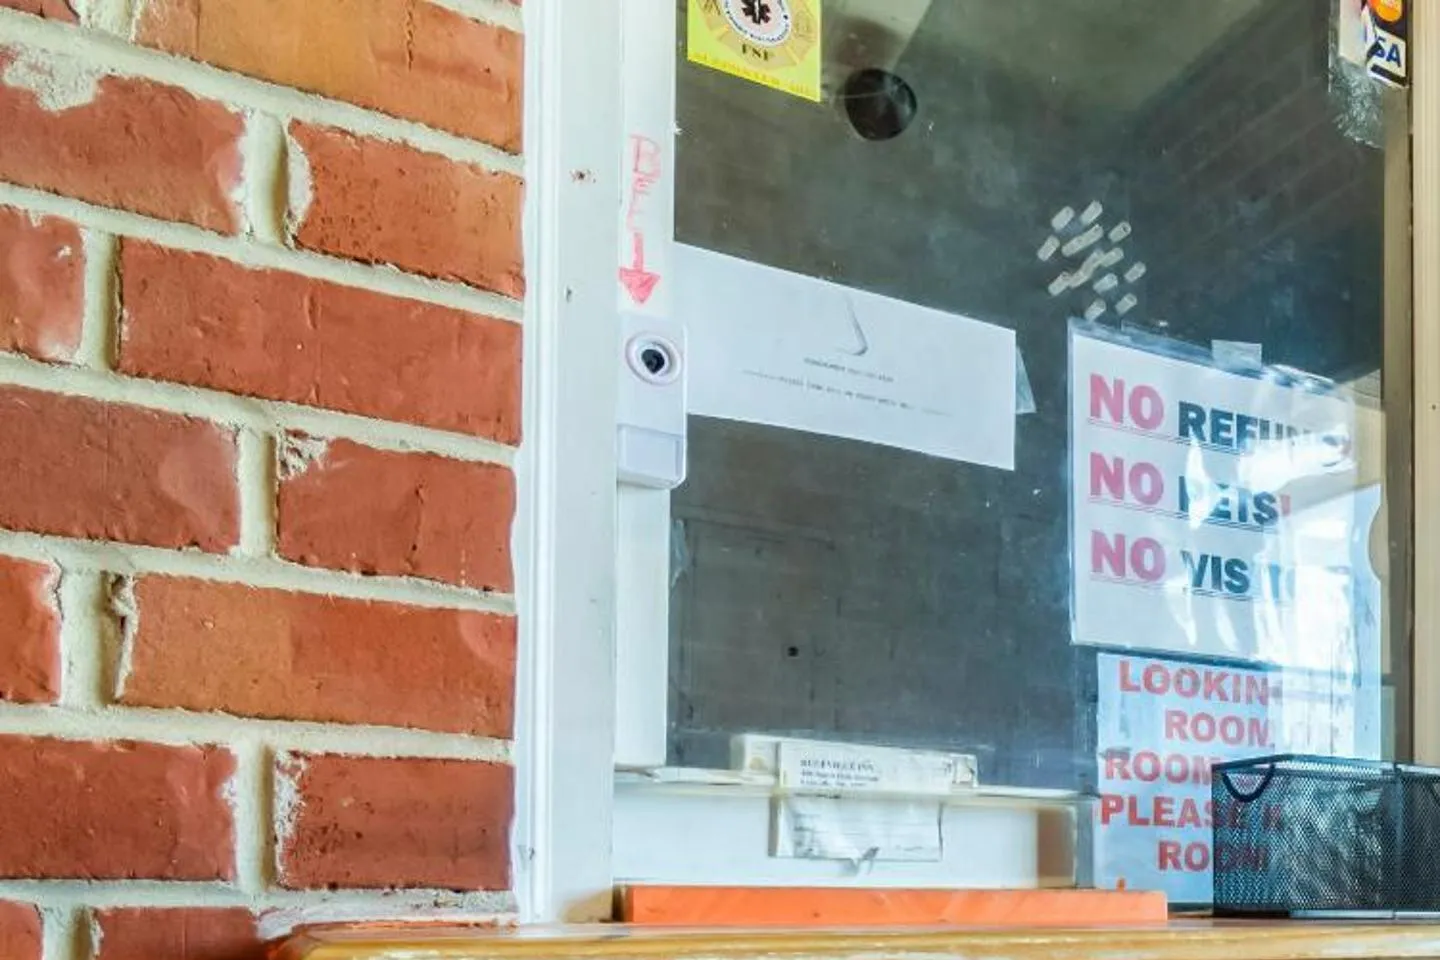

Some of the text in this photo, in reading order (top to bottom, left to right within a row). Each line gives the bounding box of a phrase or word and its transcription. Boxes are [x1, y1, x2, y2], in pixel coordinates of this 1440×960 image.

[1089, 373, 1165, 431] NO
[1089, 451, 1165, 506] NO
[1091, 529, 1167, 582] NO
[1118, 660, 1283, 706] LOOKIN
